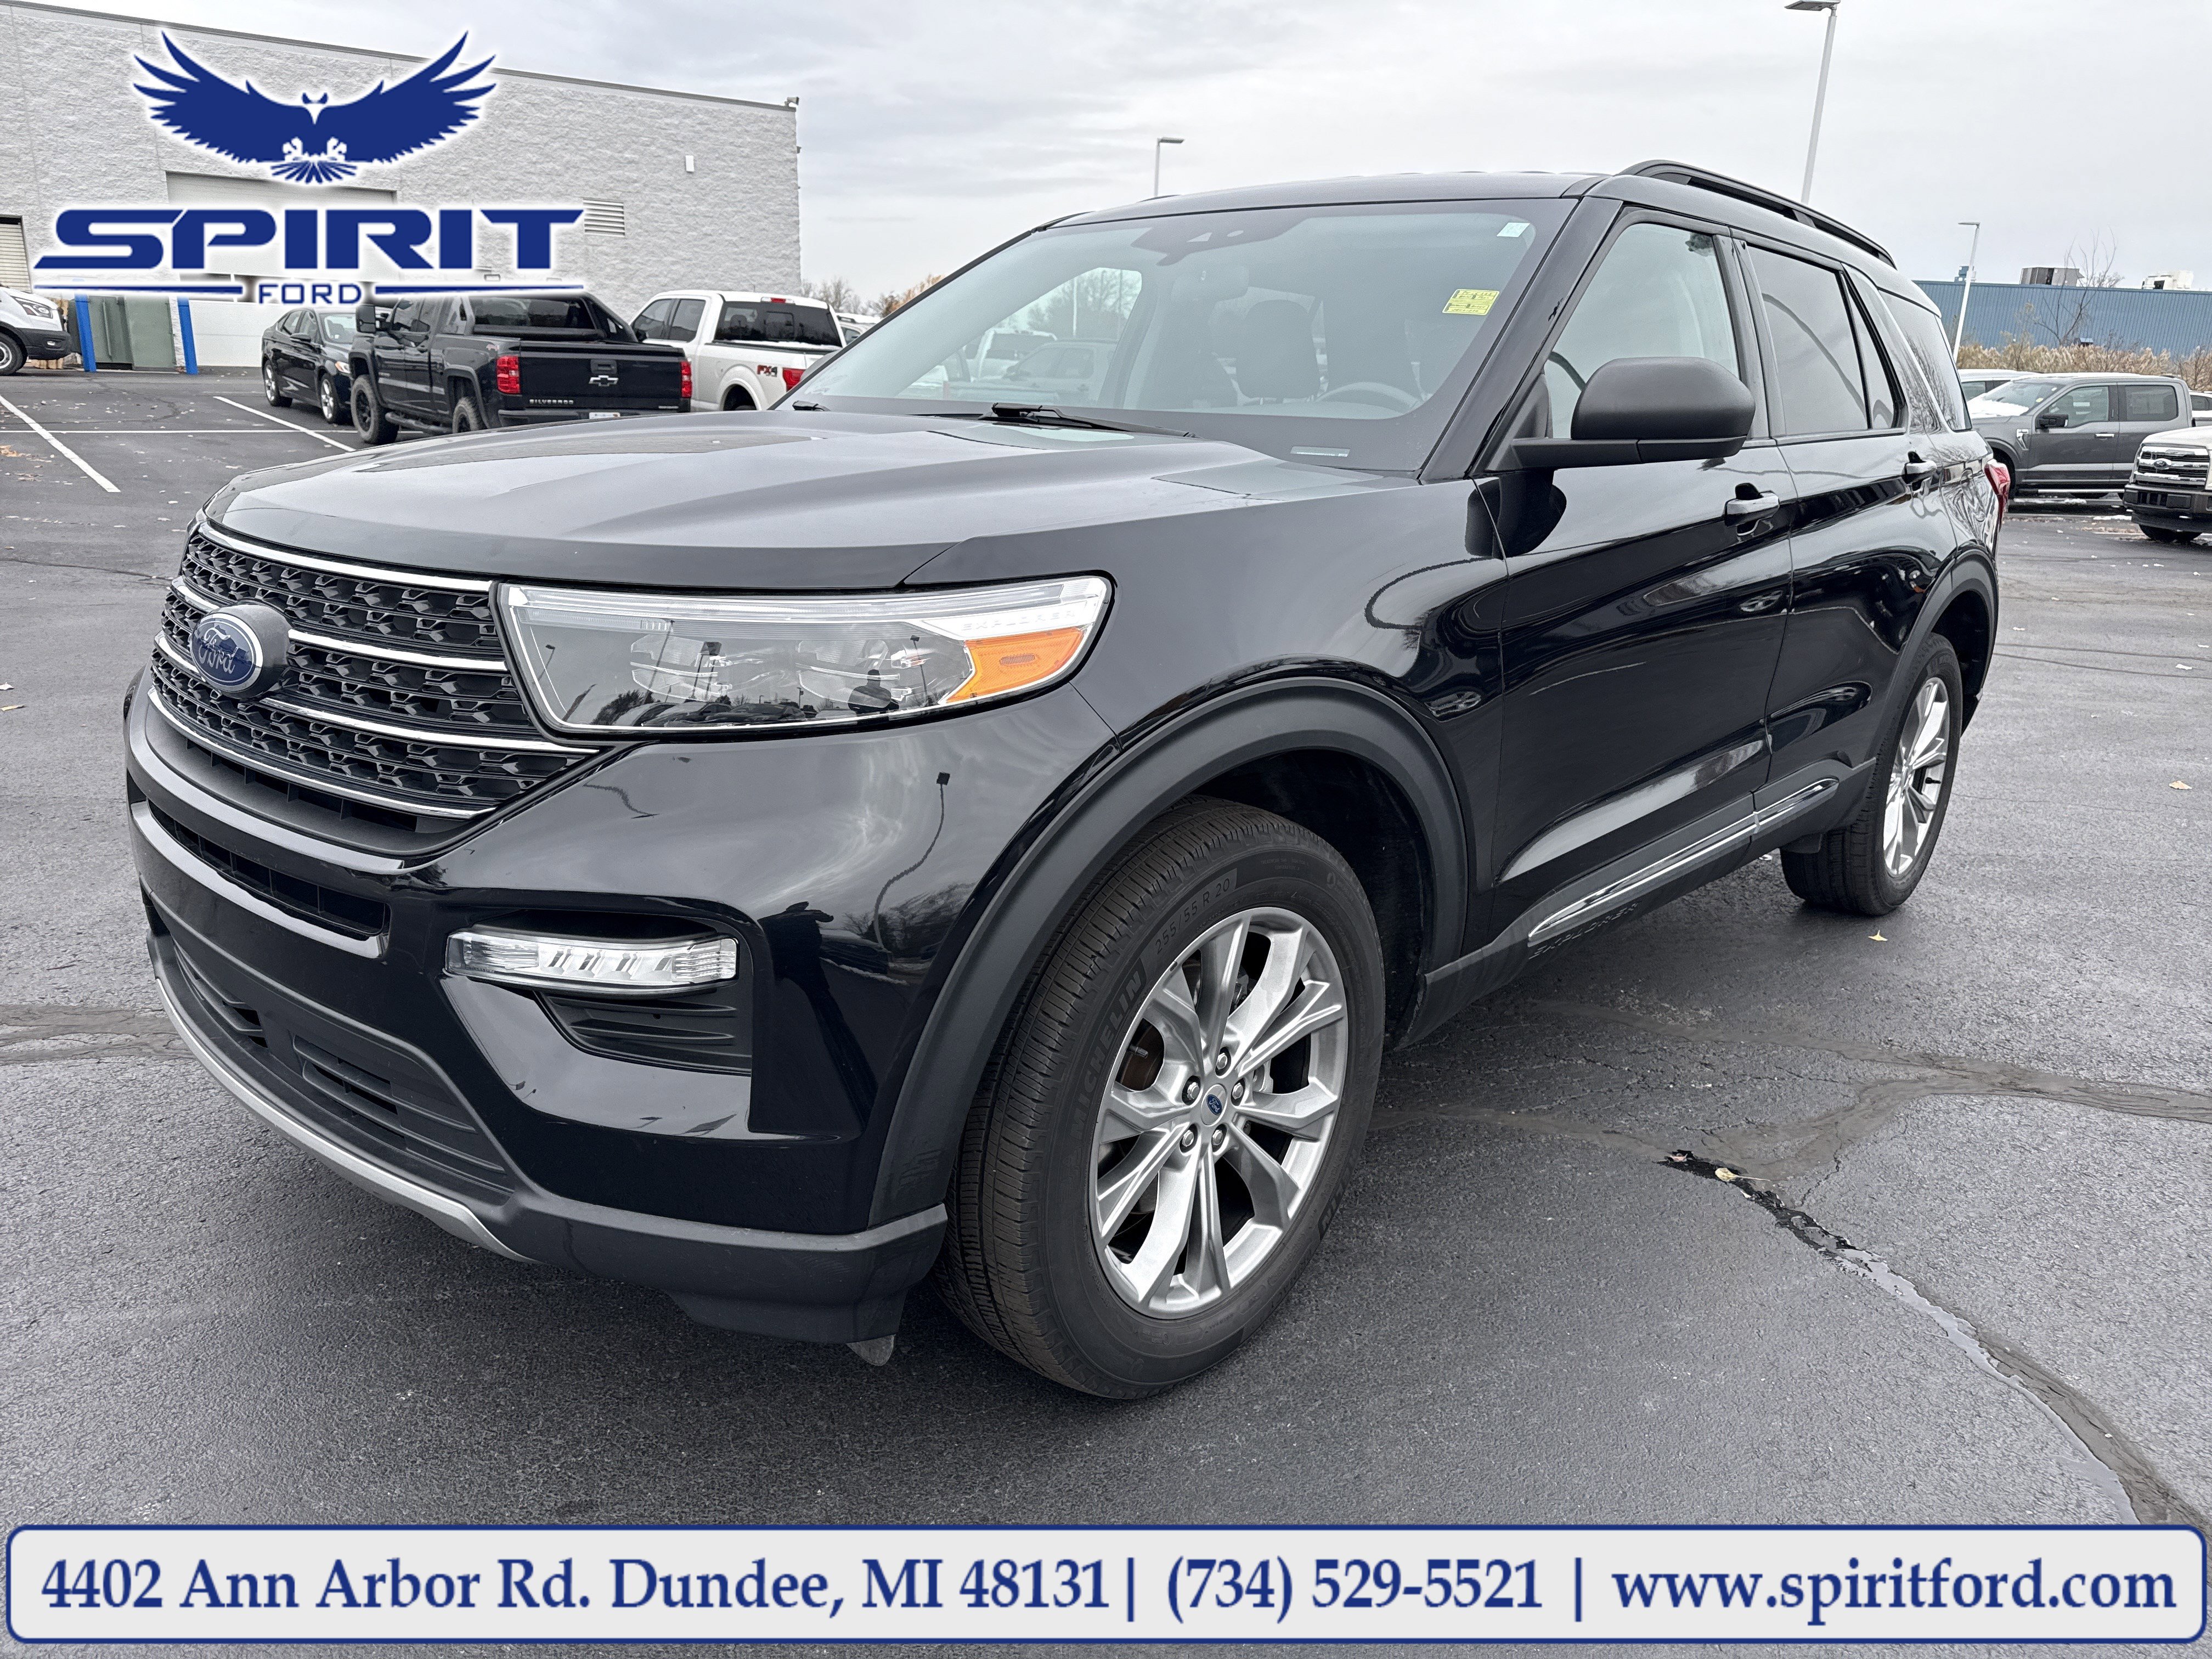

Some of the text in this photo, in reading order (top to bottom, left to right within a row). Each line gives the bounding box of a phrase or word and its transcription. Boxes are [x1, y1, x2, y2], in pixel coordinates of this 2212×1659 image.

[757, 364, 777, 377] FX4
[199, 627, 239, 674] Ford
[1155, 901, 1198, 955] 255/55
[1202, 891, 1210, 907] R
[1215, 878, 1230, 898] 20
[1070, 970, 1142, 1140] MICHELIN
